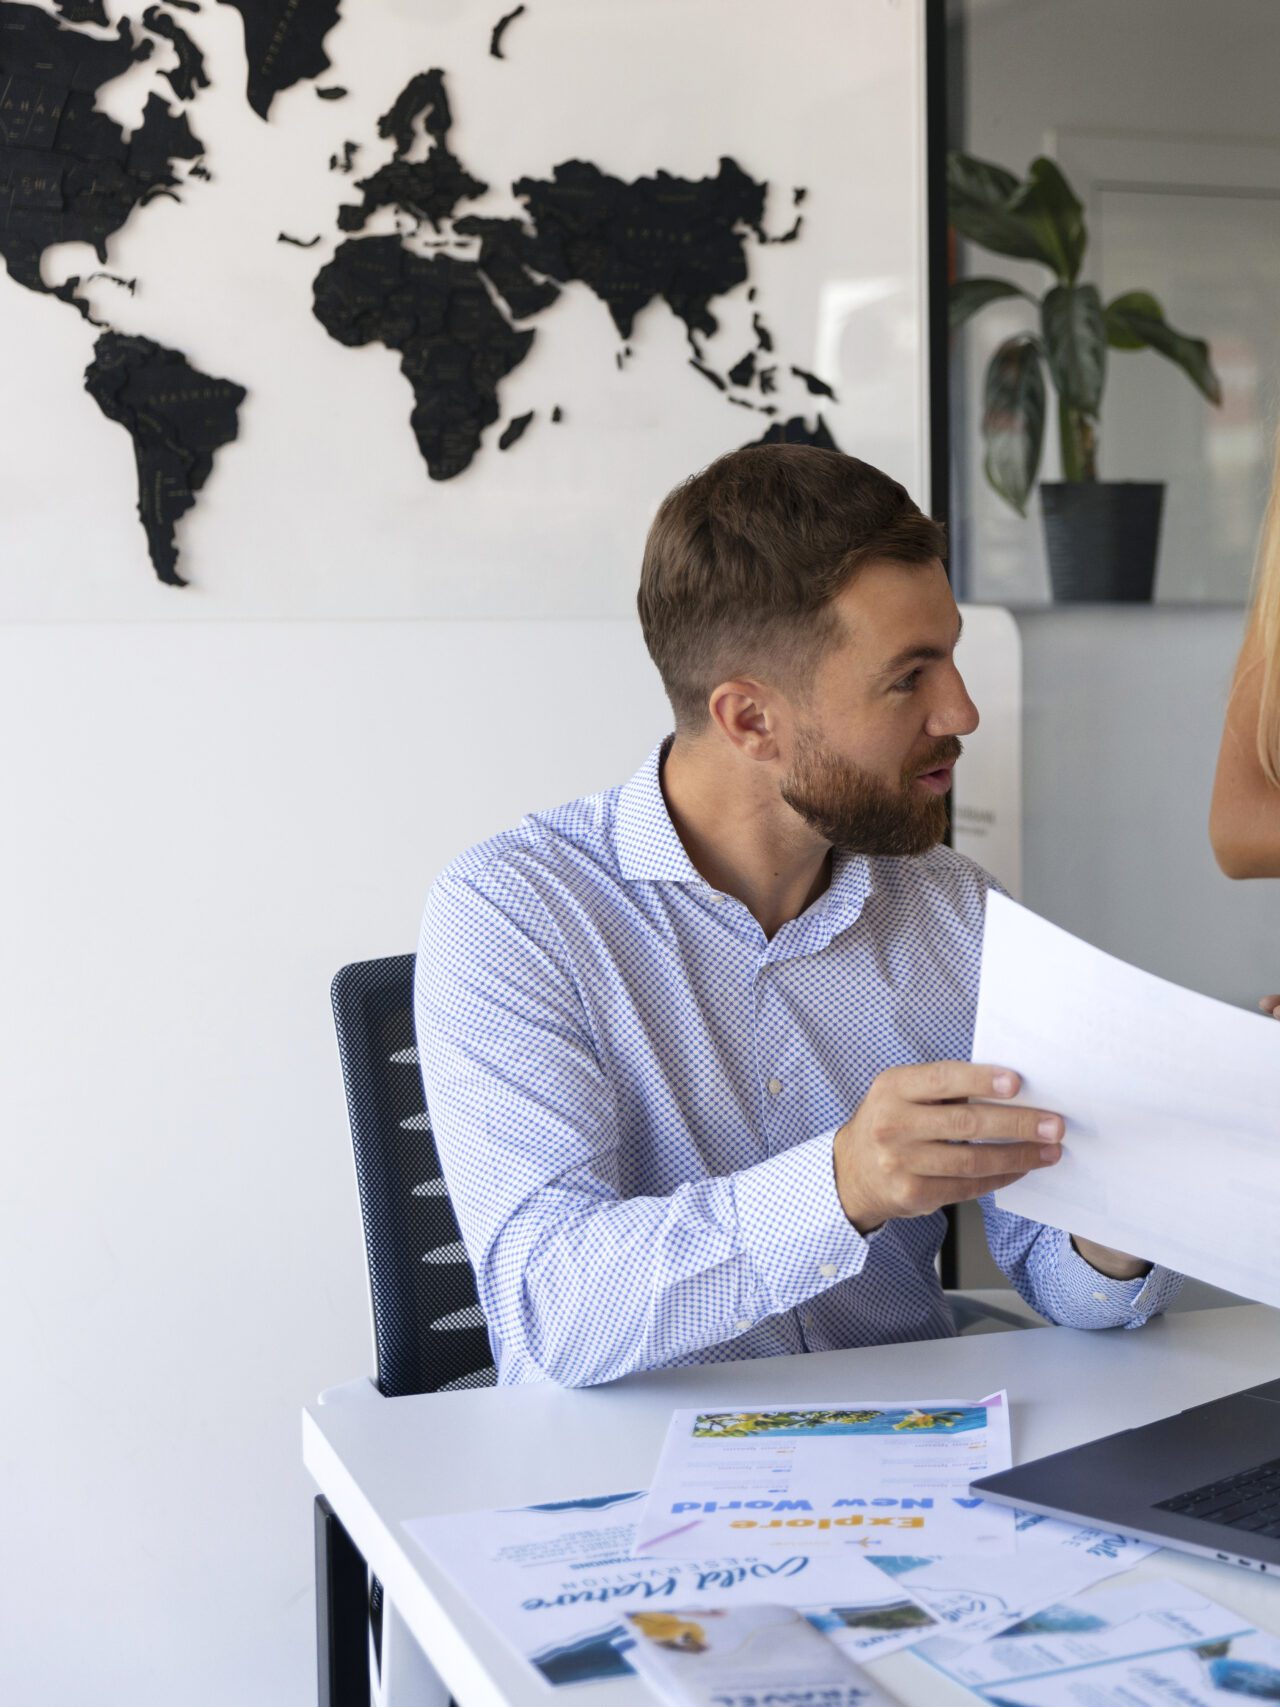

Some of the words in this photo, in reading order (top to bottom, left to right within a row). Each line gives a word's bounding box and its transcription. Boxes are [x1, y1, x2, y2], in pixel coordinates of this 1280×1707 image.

[671, 1499, 814, 1514] World
[832, 1498, 934, 1509] New
[952, 1498, 985, 1509] A
[729, 1515, 925, 1530] Explore
[697, 1556, 810, 1591] Wild
[521, 1576, 678, 1611] Nature
